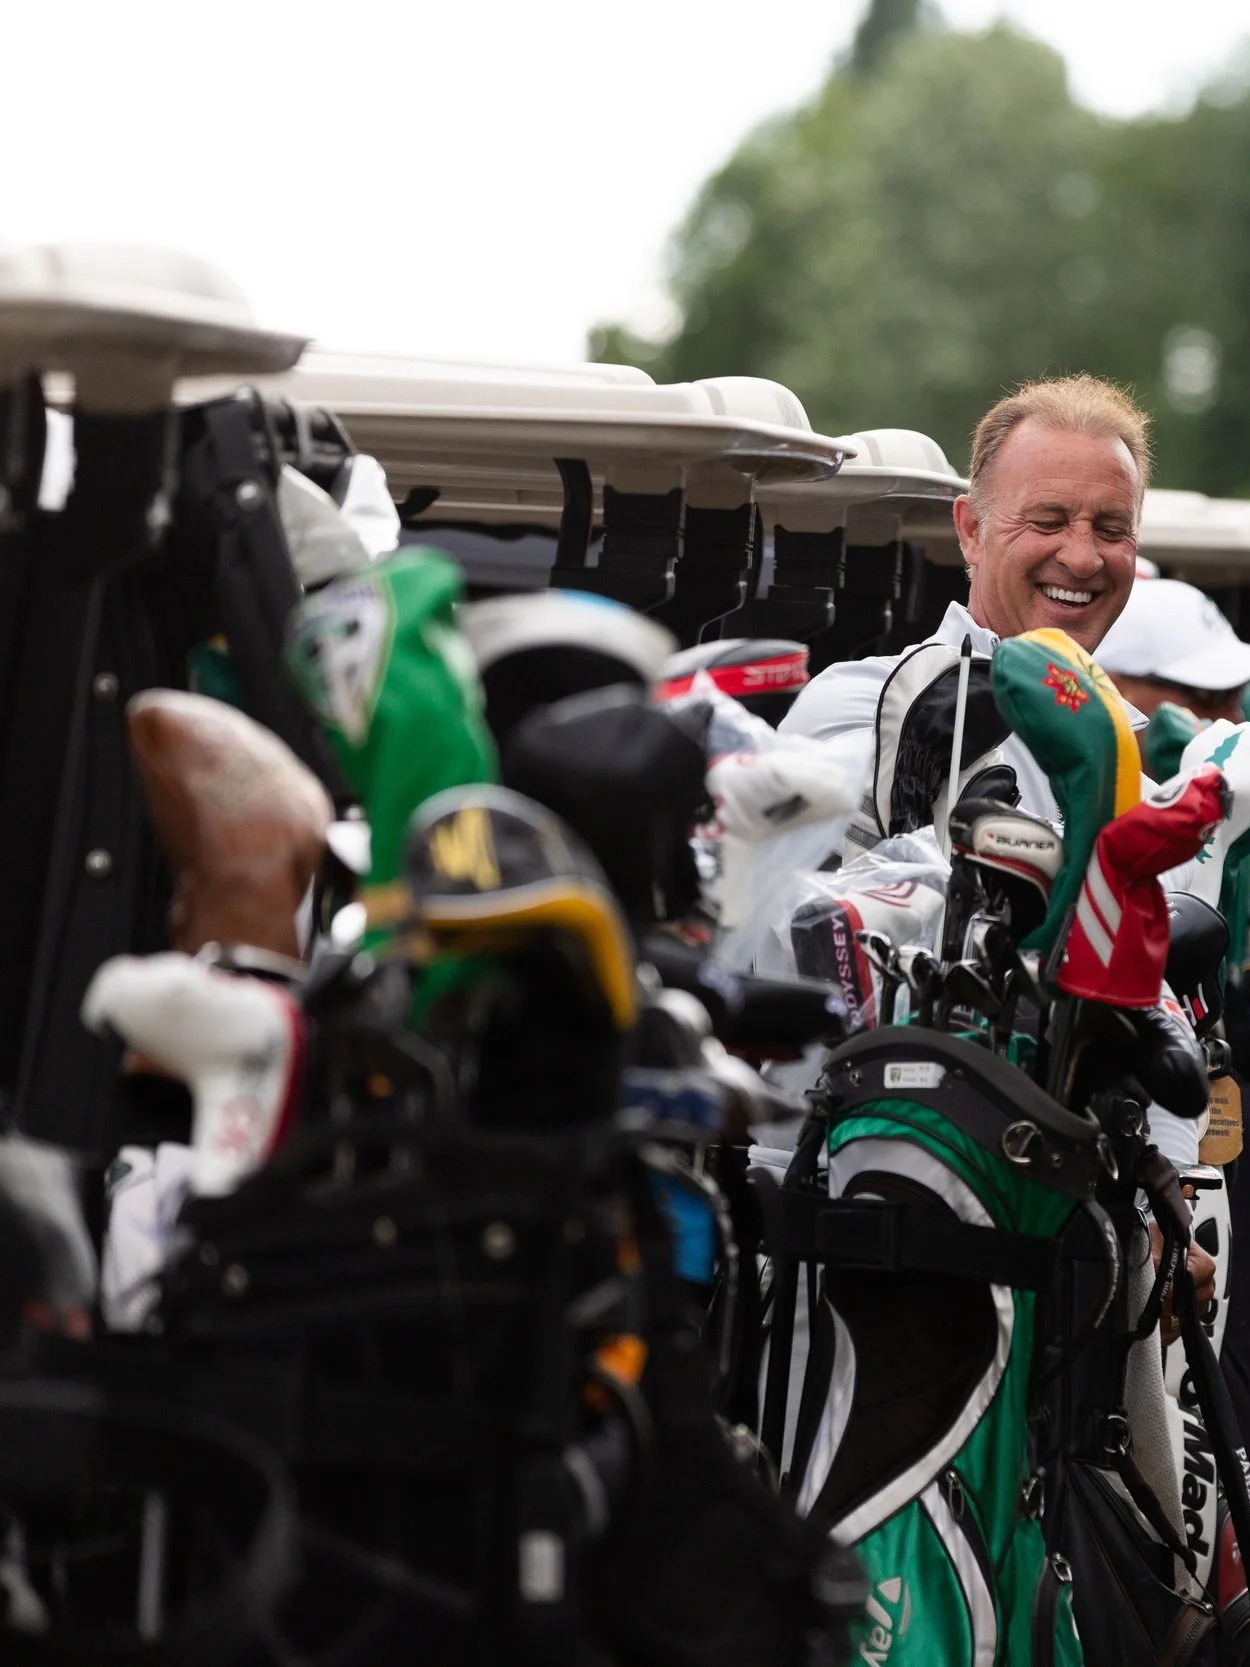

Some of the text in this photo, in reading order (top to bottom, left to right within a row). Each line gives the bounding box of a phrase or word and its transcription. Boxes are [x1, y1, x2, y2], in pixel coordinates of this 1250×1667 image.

[996, 836, 1055, 850] BURNER
[832, 917, 861, 1026] ODYSSEY
[1211, 1107, 1221, 1115] the
[1209, 1118, 1239, 1127] xecutives
